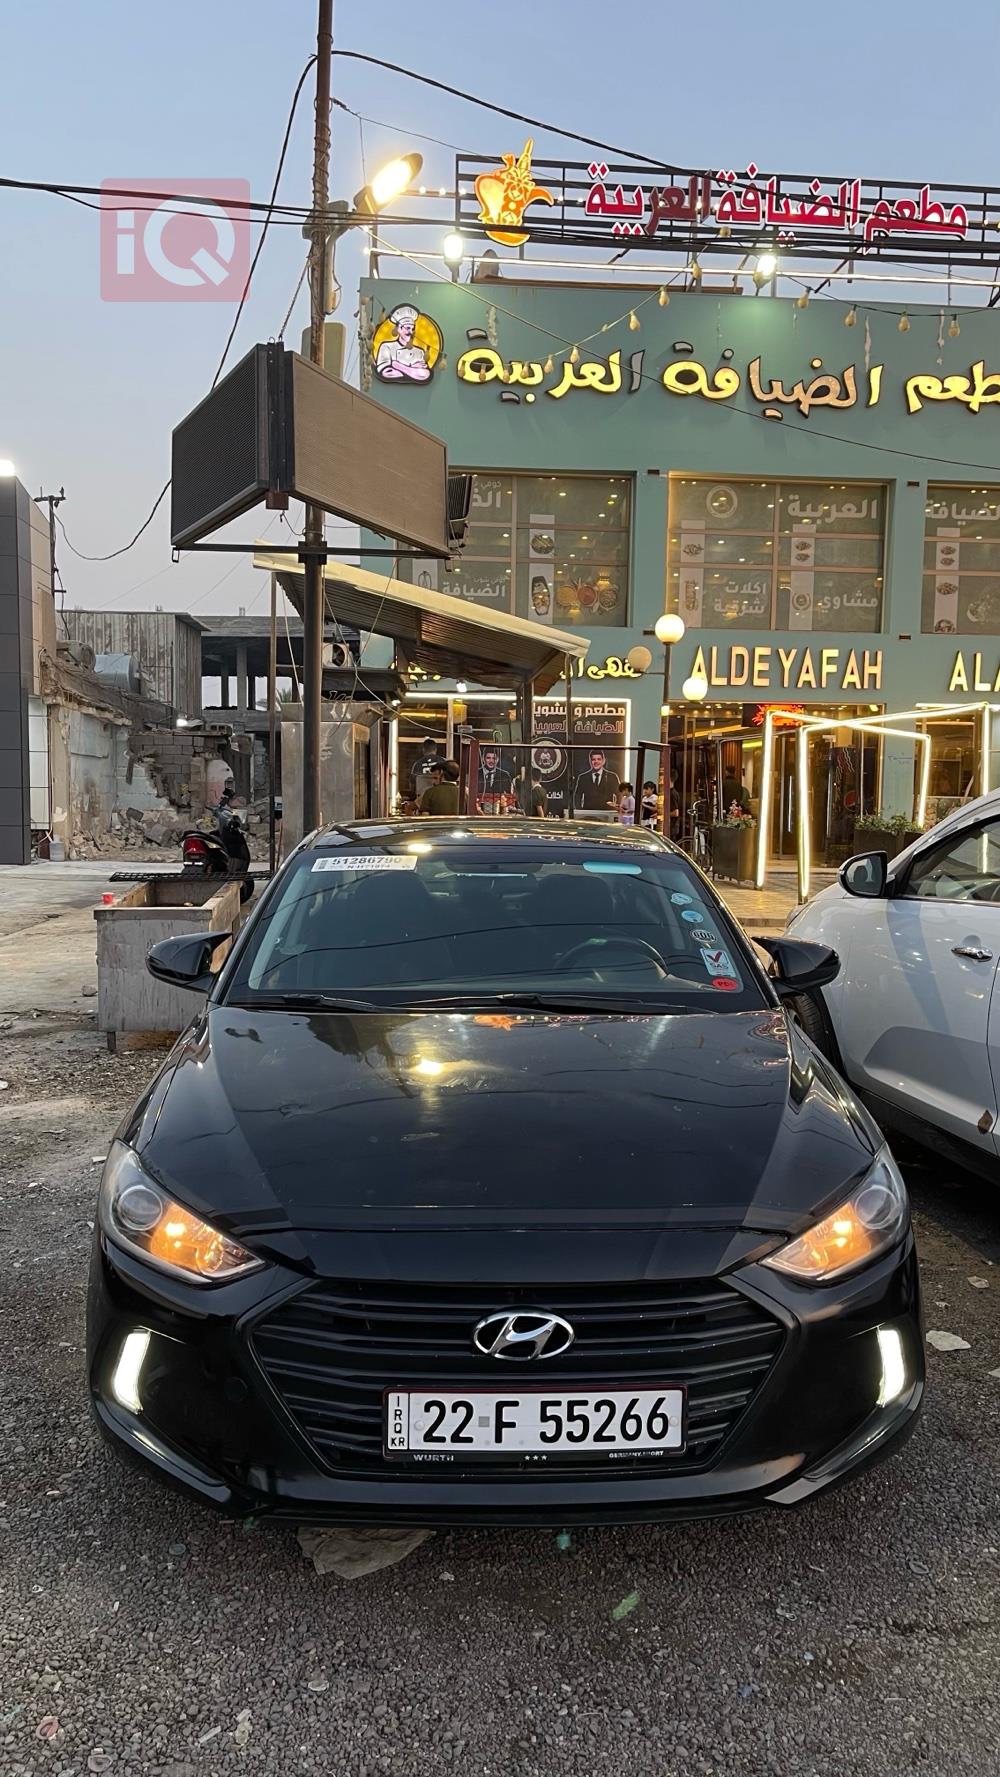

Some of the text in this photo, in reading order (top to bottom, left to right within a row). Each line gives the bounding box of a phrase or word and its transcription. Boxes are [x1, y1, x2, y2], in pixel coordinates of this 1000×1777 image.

[584, 160, 969, 254] مطعم الضيافة العربية
[456, 328, 1000, 420] طعم الضيافة العربية
[787, 494, 878, 524] العربية
[925, 499, 1000, 526] لضيافة
[442, 581, 506, 600] الضيافة
[820, 591, 878, 613] مشاوي
[713, 598, 765, 617] شرقية
[690, 645, 883, 690] ALDEYAFAH
[949, 650, 1000, 692] AL
[585, 703, 626, 718] مطعم
[574, 720, 625, 735] الضيافة
[423, 1397, 669, 1444] 22 F 55266
[390, 1436, 405, 1447] KR
